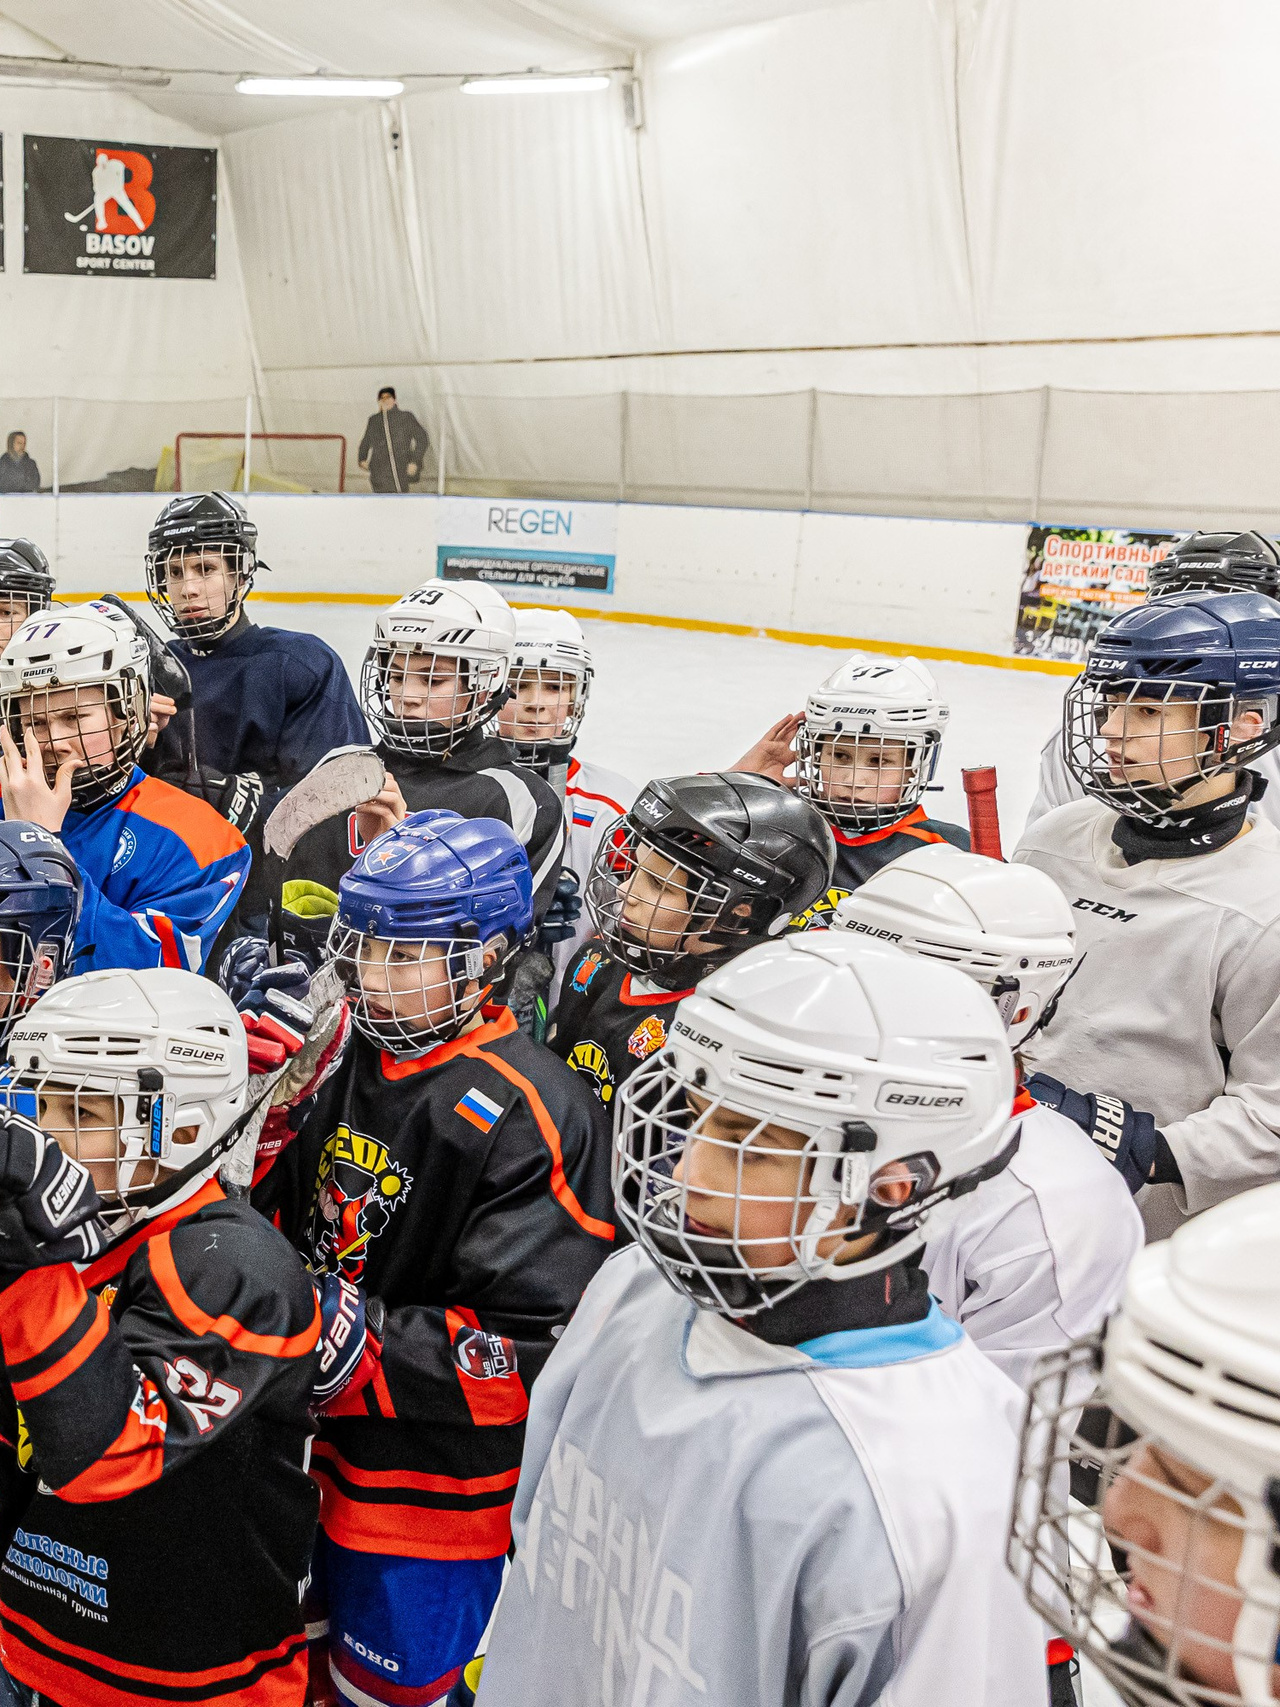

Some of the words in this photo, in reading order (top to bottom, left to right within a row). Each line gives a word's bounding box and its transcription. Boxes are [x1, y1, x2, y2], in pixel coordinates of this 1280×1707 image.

[86, 233, 155, 256] BASOV
[76, 256, 111, 269] SPORT
[112, 258, 155, 271] CENTER
[487, 507, 573, 536] REGEN
[163, 525, 196, 537] BAUER
[1115, 566, 1147, 584] сад
[25, 621, 62, 642] 77
[391, 625, 428, 635] CCM
[514, 641, 554, 649] BAUER
[1087, 656, 1129, 671] CCM
[1237, 660, 1280, 670] CCM
[22, 666, 54, 679] BAUER
[831, 706, 878, 716] BAUER
[732, 866, 768, 886] CCM
[1071, 896, 1139, 924] CCM
[845, 919, 903, 944] BAUER
[11, 1030, 48, 1042] BAUER
[673, 1020, 724, 1053] BAUER
[169, 1045, 226, 1062] BAUER
[885, 1092, 965, 1108] BAUER
[152, 1095, 162, 1157] BAUER
[71, 1600, 109, 1624] группа
[343, 1631, 400, 1673] KOHO
